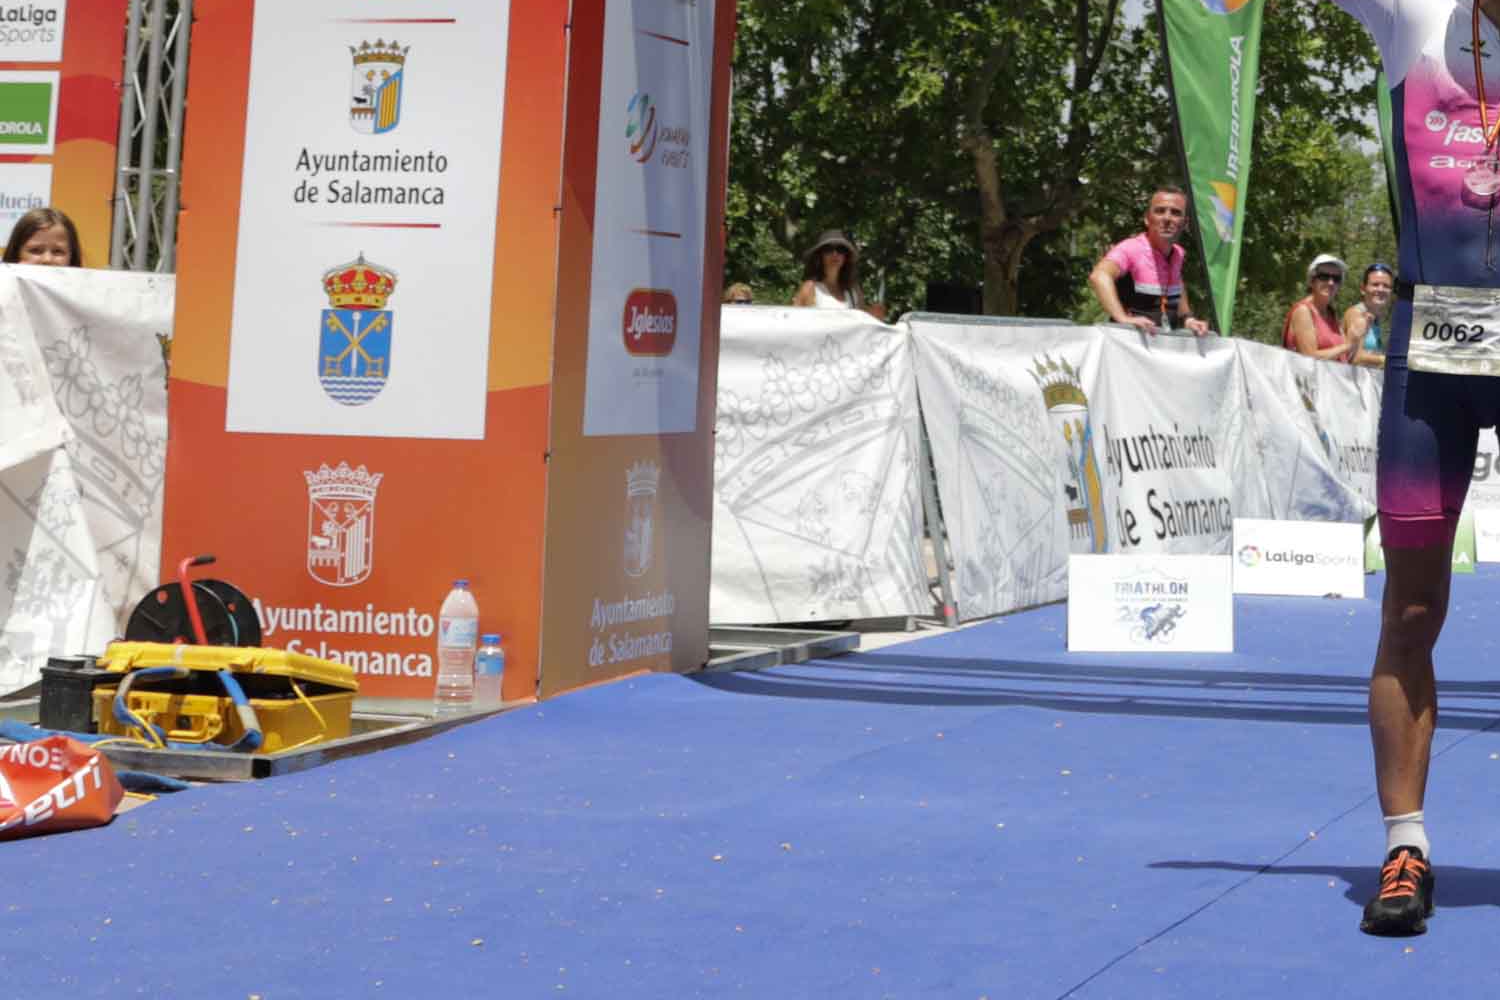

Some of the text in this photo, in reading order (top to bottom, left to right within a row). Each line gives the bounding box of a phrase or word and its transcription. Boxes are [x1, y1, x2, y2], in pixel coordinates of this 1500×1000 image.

[296, 147, 448, 177] Ayuntamiento
[294, 179, 444, 205] de Salamanca
[1422, 321, 1485, 343] 0062
[287, 640, 433, 678] lamanca
